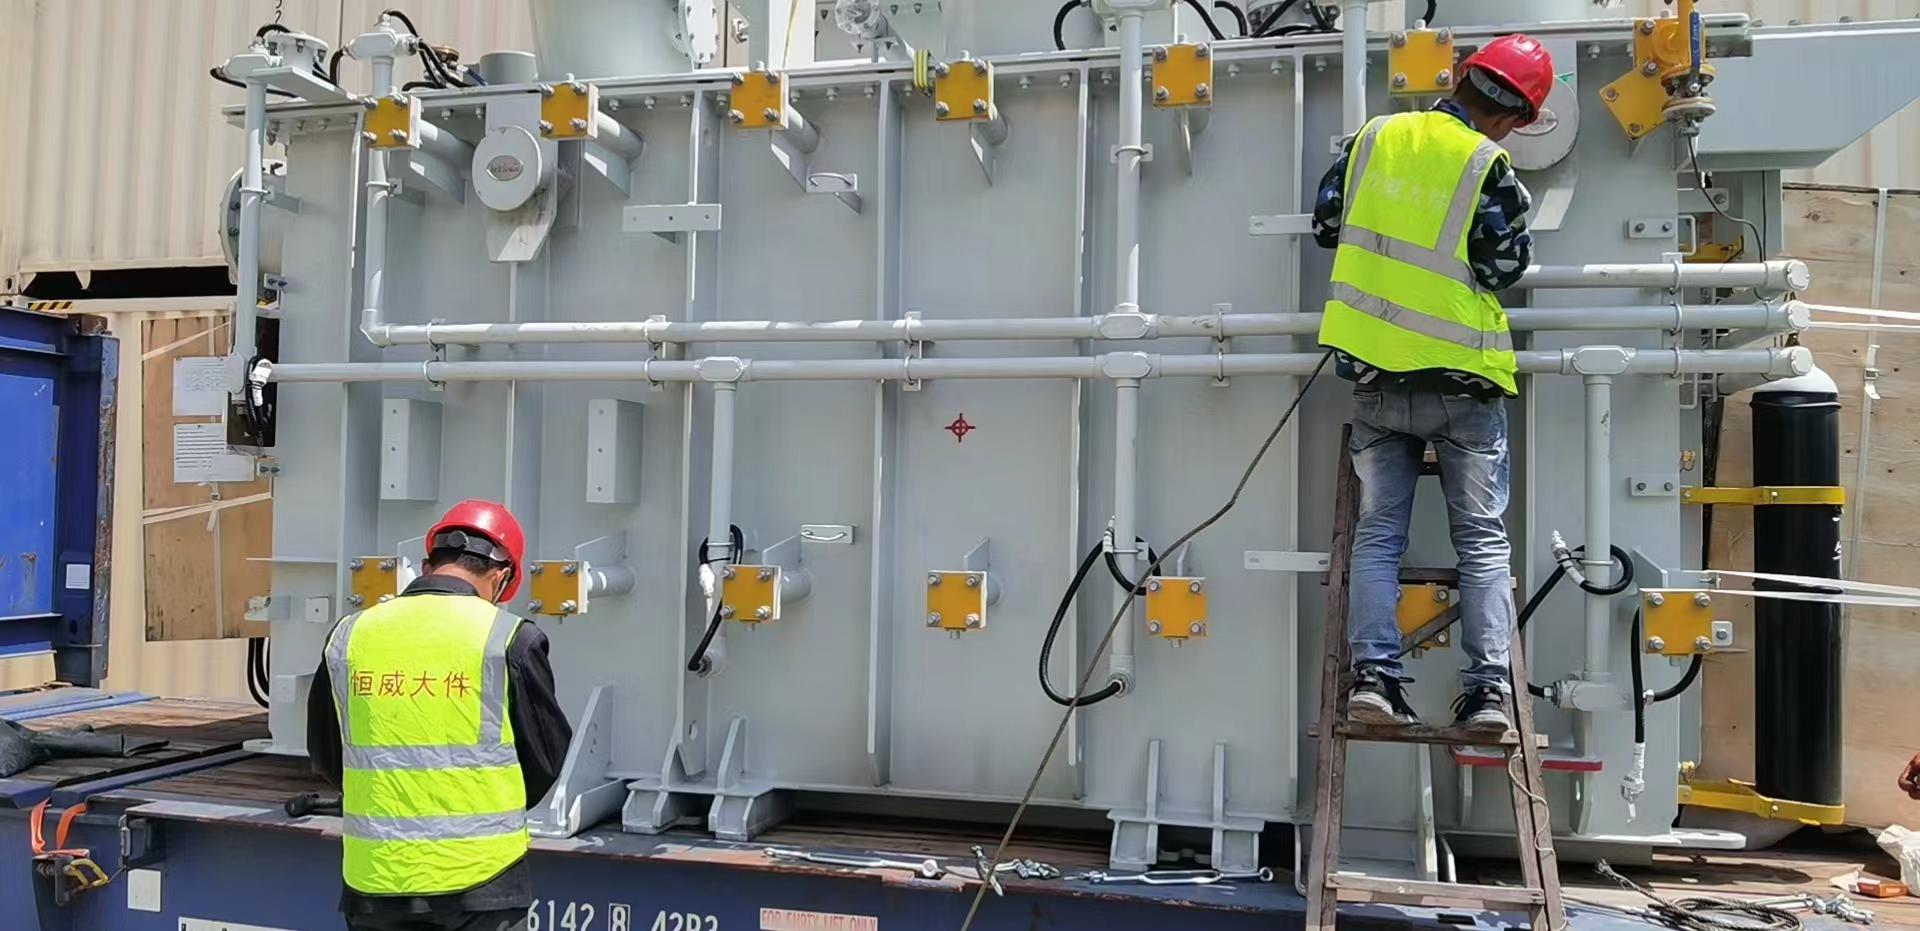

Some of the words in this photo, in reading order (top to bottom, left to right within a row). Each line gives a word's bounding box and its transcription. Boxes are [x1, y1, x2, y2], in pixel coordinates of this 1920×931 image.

[351, 669, 472, 698] 恒威大件
[527, 898, 595, 931] 6142
[611, 905, 627, 931] 8
